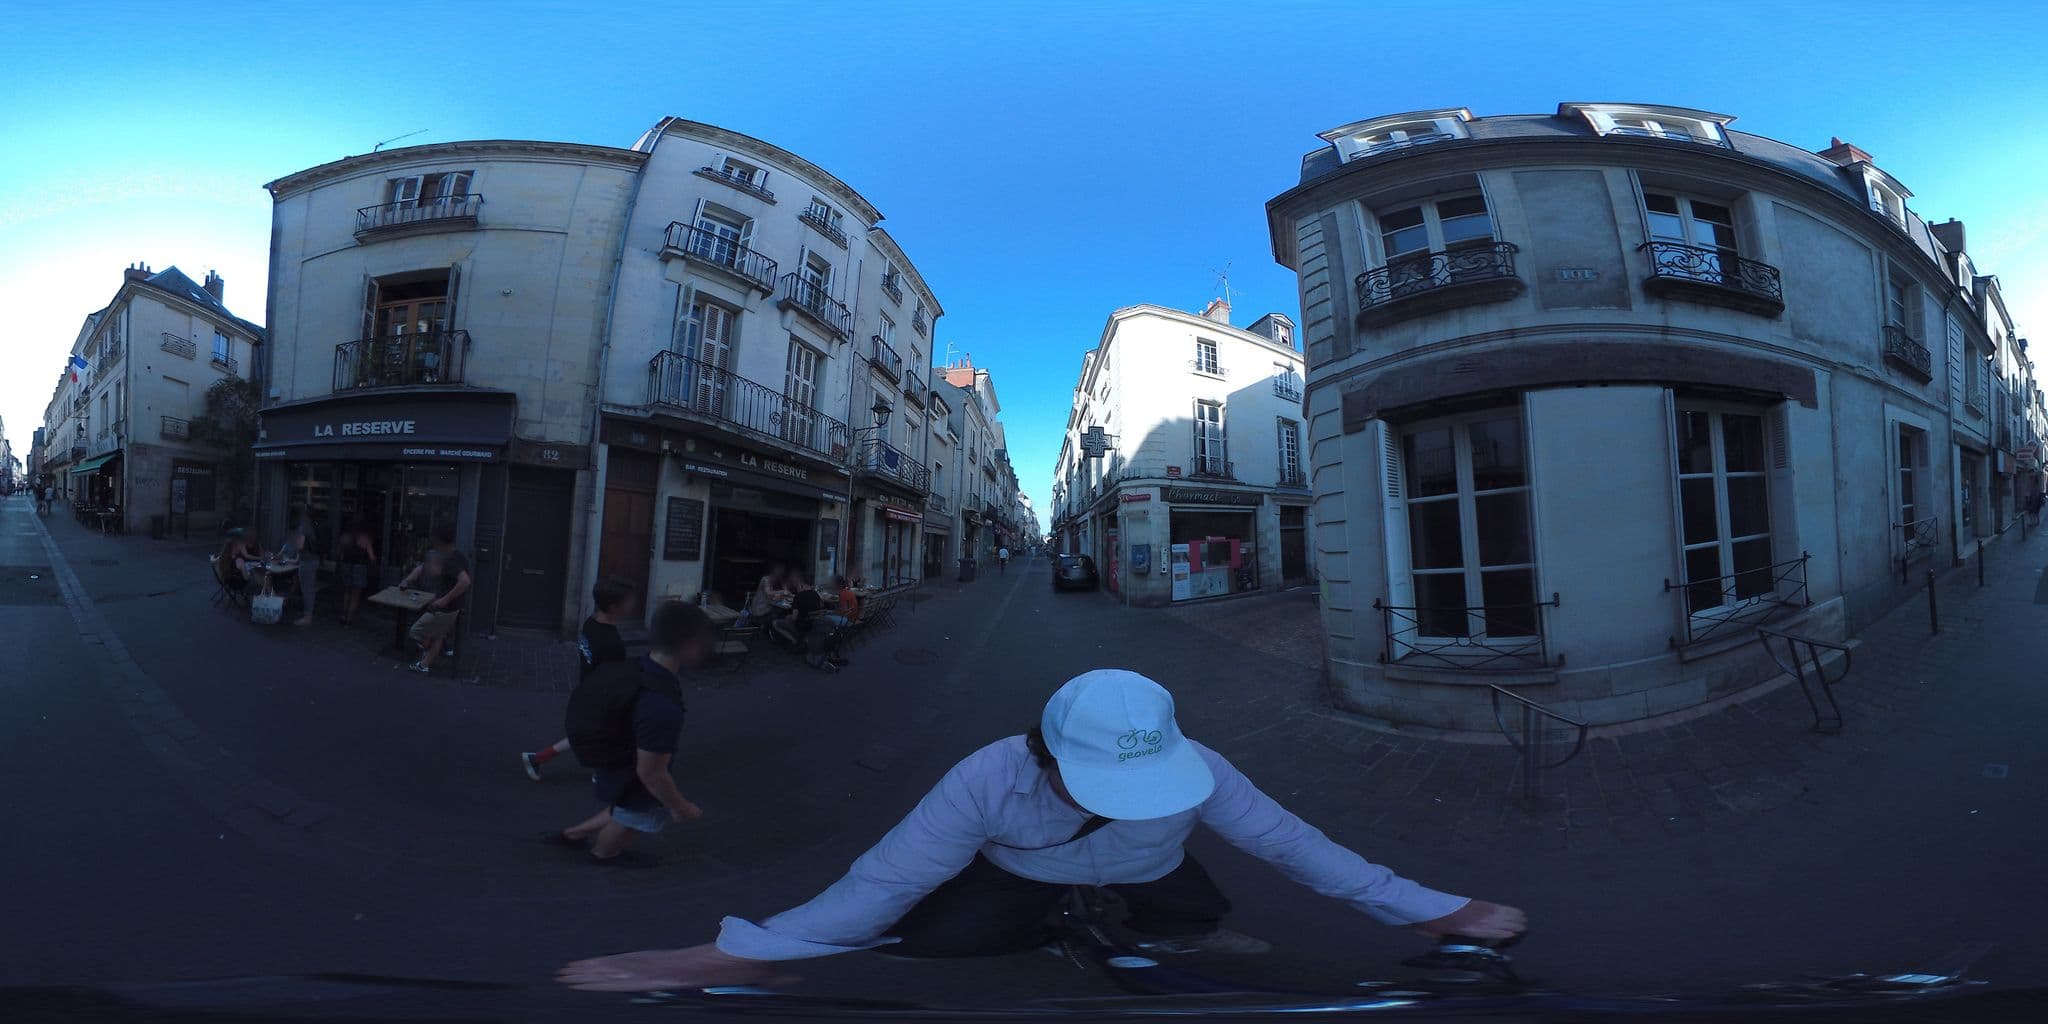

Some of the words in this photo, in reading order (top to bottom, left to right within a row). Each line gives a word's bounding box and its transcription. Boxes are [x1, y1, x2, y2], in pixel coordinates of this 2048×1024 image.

[314, 424, 334, 437] LA
[342, 420, 415, 436] RESERVE
[544, 449, 560, 461] 82
[741, 453, 757, 467] LA
[764, 460, 807, 480] RESERVE
[1119, 745, 1161, 762] geovelo
